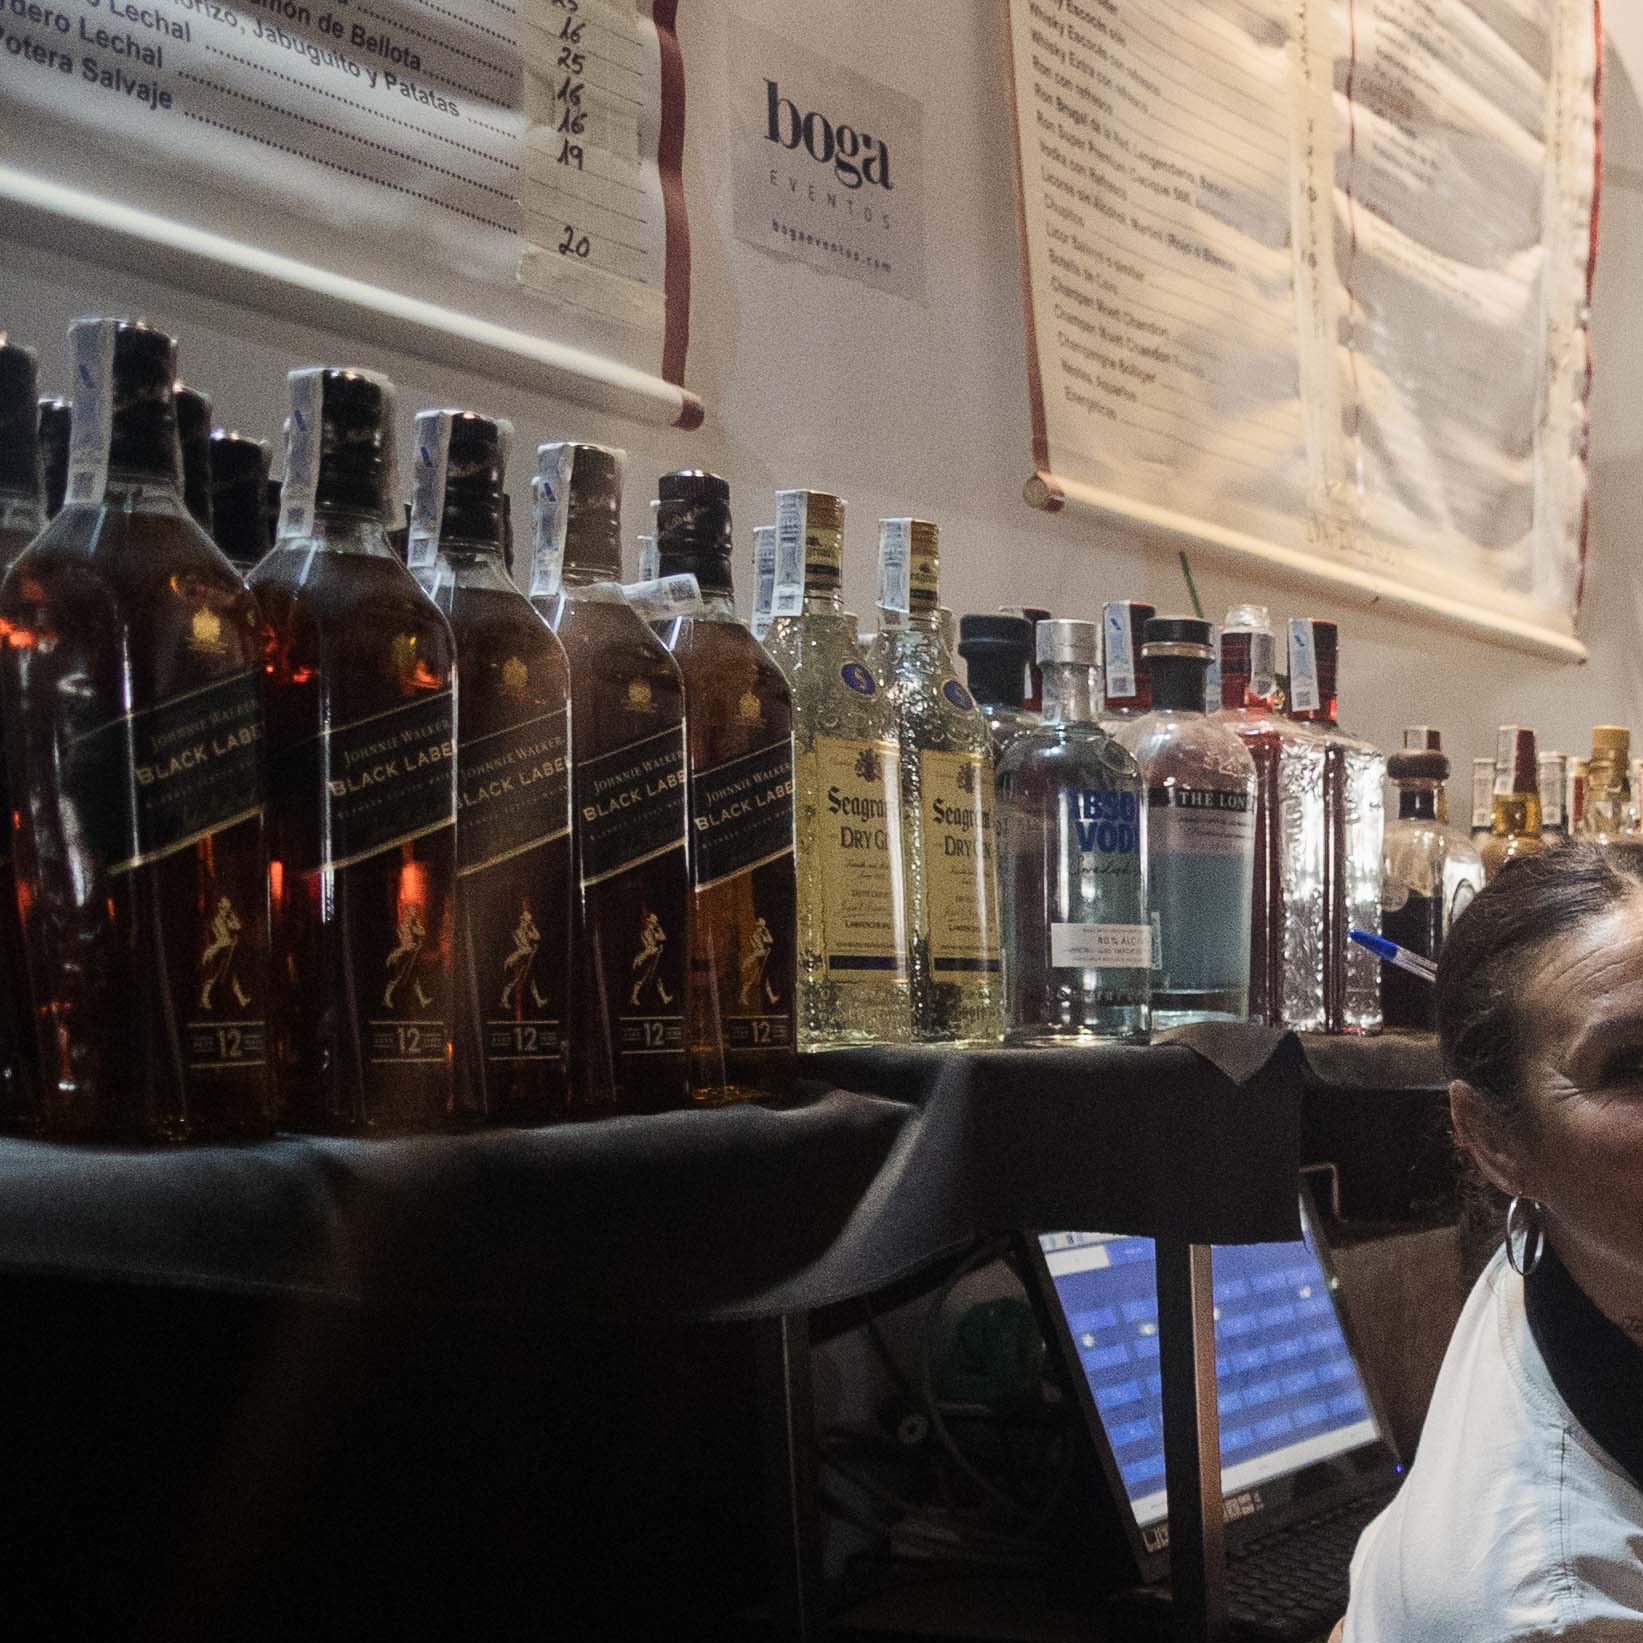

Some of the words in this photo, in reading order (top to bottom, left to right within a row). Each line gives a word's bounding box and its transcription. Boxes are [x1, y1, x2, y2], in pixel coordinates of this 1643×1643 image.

[0, 0, 71, 34] dero
[80, 17, 164, 69] Lechal
[318, 13, 345, 39] de
[351, 23, 423, 73] Bellota
[559, 17, 587, 44] 16
[253, 20, 361, 80] Jabuguito
[365, 67, 378, 90] y
[383, 70, 461, 119] Patatas
[557, 46, 585, 76] 25
[82, 57, 174, 111] Salvaje
[556, 76, 585, 107] 16
[558, 107, 588, 135] 16
[762, 76, 894, 191] boga
[557, 139, 584, 171] 19
[769, 168, 891, 231] EVENTOS
[558, 225, 591, 259] 20
[135, 744, 208, 785] BLACK
[212, 721, 265, 757] LABE
[331, 760, 400, 797] BLACK
[404, 741, 457, 772] LABE
[582, 787, 643, 823] BLACK
[646, 769, 687, 797] LABE
[693, 798, 753, 832] BLACK
[756, 780, 795, 807] LABE
[1179, 791, 1214, 807] THE
[1219, 793, 1247, 809] LON
[841, 826, 873, 851] DRY
[944, 835, 973, 859] DRY
[1076, 821, 1139, 854] VOD
[217, 1028, 243, 1059] 12
[397, 1027, 422, 1055] 12
[514, 1025, 538, 1053] 12
[644, 1022, 666, 1048] 12
[752, 1021, 773, 1045] 12
